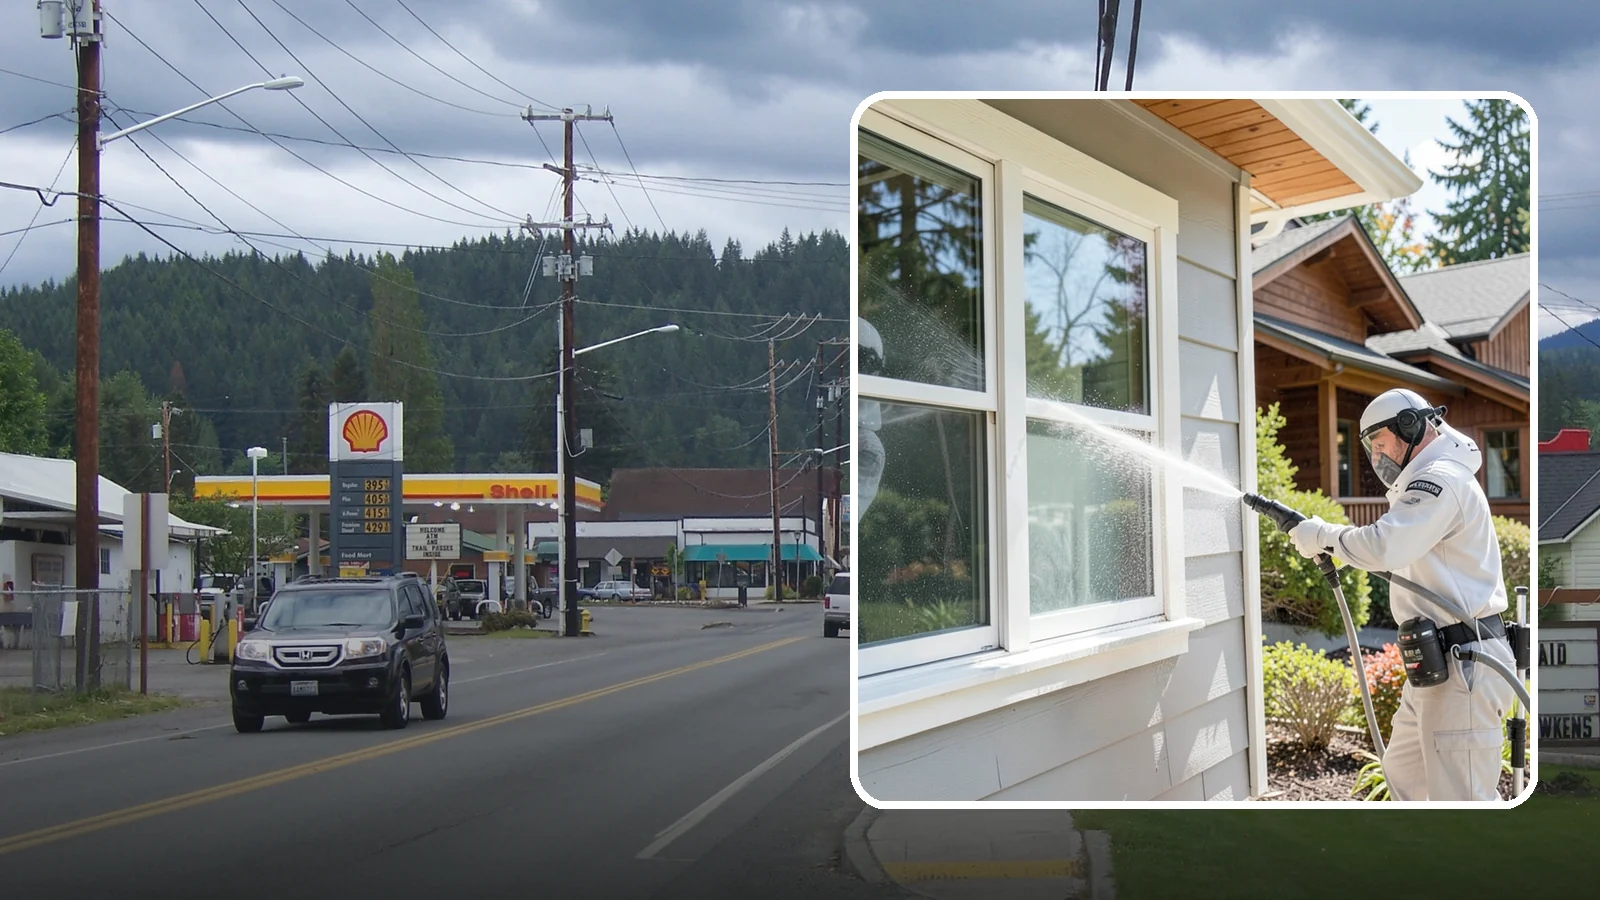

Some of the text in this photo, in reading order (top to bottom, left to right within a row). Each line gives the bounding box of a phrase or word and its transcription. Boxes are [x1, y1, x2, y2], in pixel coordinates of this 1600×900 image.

[366, 480, 383, 490] 395
[490, 484, 547, 499] Shell
[366, 494, 383, 504] 405
[366, 508, 383, 518] 415
[366, 522, 383, 532] 429
